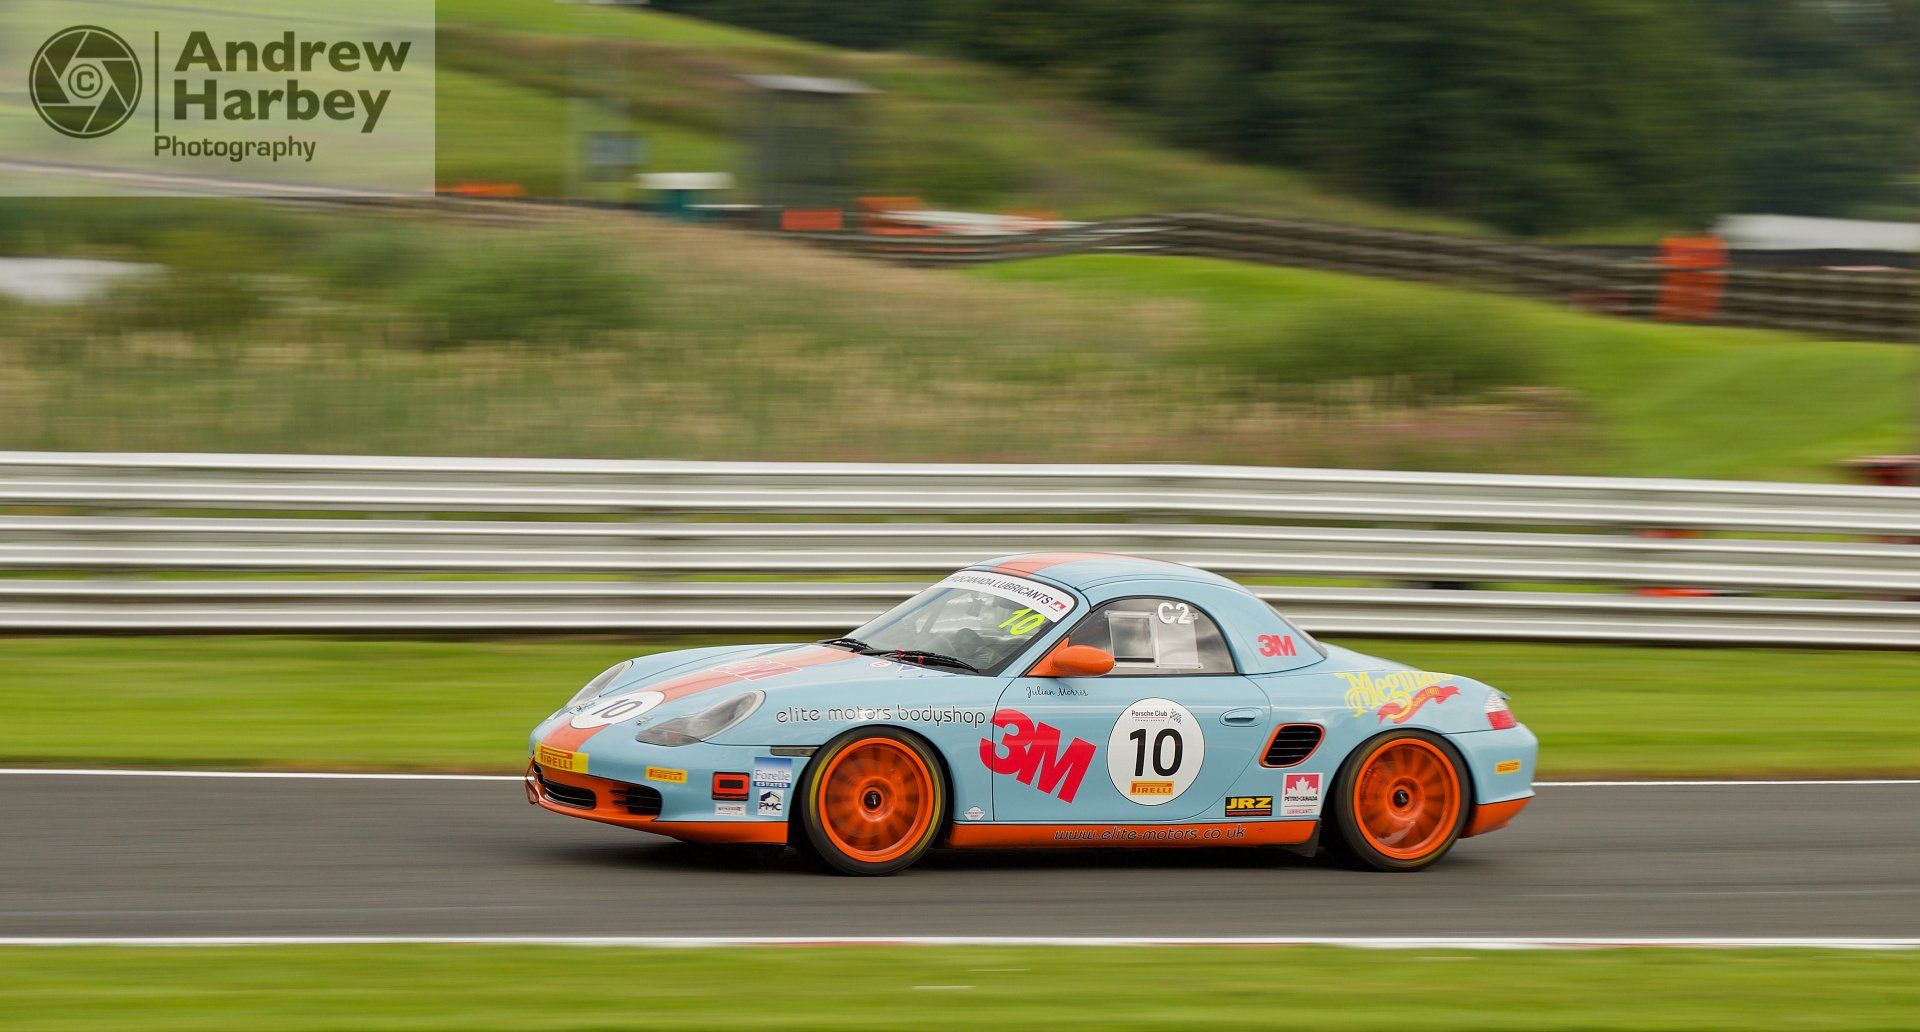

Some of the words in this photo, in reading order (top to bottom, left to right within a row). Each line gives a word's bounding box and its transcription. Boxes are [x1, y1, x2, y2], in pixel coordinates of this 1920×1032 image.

[992, 580, 1054, 605] LUBRICANTS
[999, 608, 1046, 635] 10
[1157, 602, 1191, 624] C2
[1257, 633, 1297, 657] 3M
[1026, 685, 1055, 698] Julian
[591, 698, 643, 719] 10
[776, 706, 820, 722] elite
[828, 706, 892, 722] motors
[898, 704, 986, 728] bodyshop
[540, 745, 573, 770] PIRELLI
[979, 708, 1097, 804] 3M
[1130, 728, 1183, 777] 10
[755, 769, 790, 781] Forelle
[1131, 782, 1173, 793] PIRELLI
[759, 802, 782, 811] PMC
[1226, 797, 1272, 809] JRZ
[1054, 825, 1246, 841] www.elite-motors.co.uk
